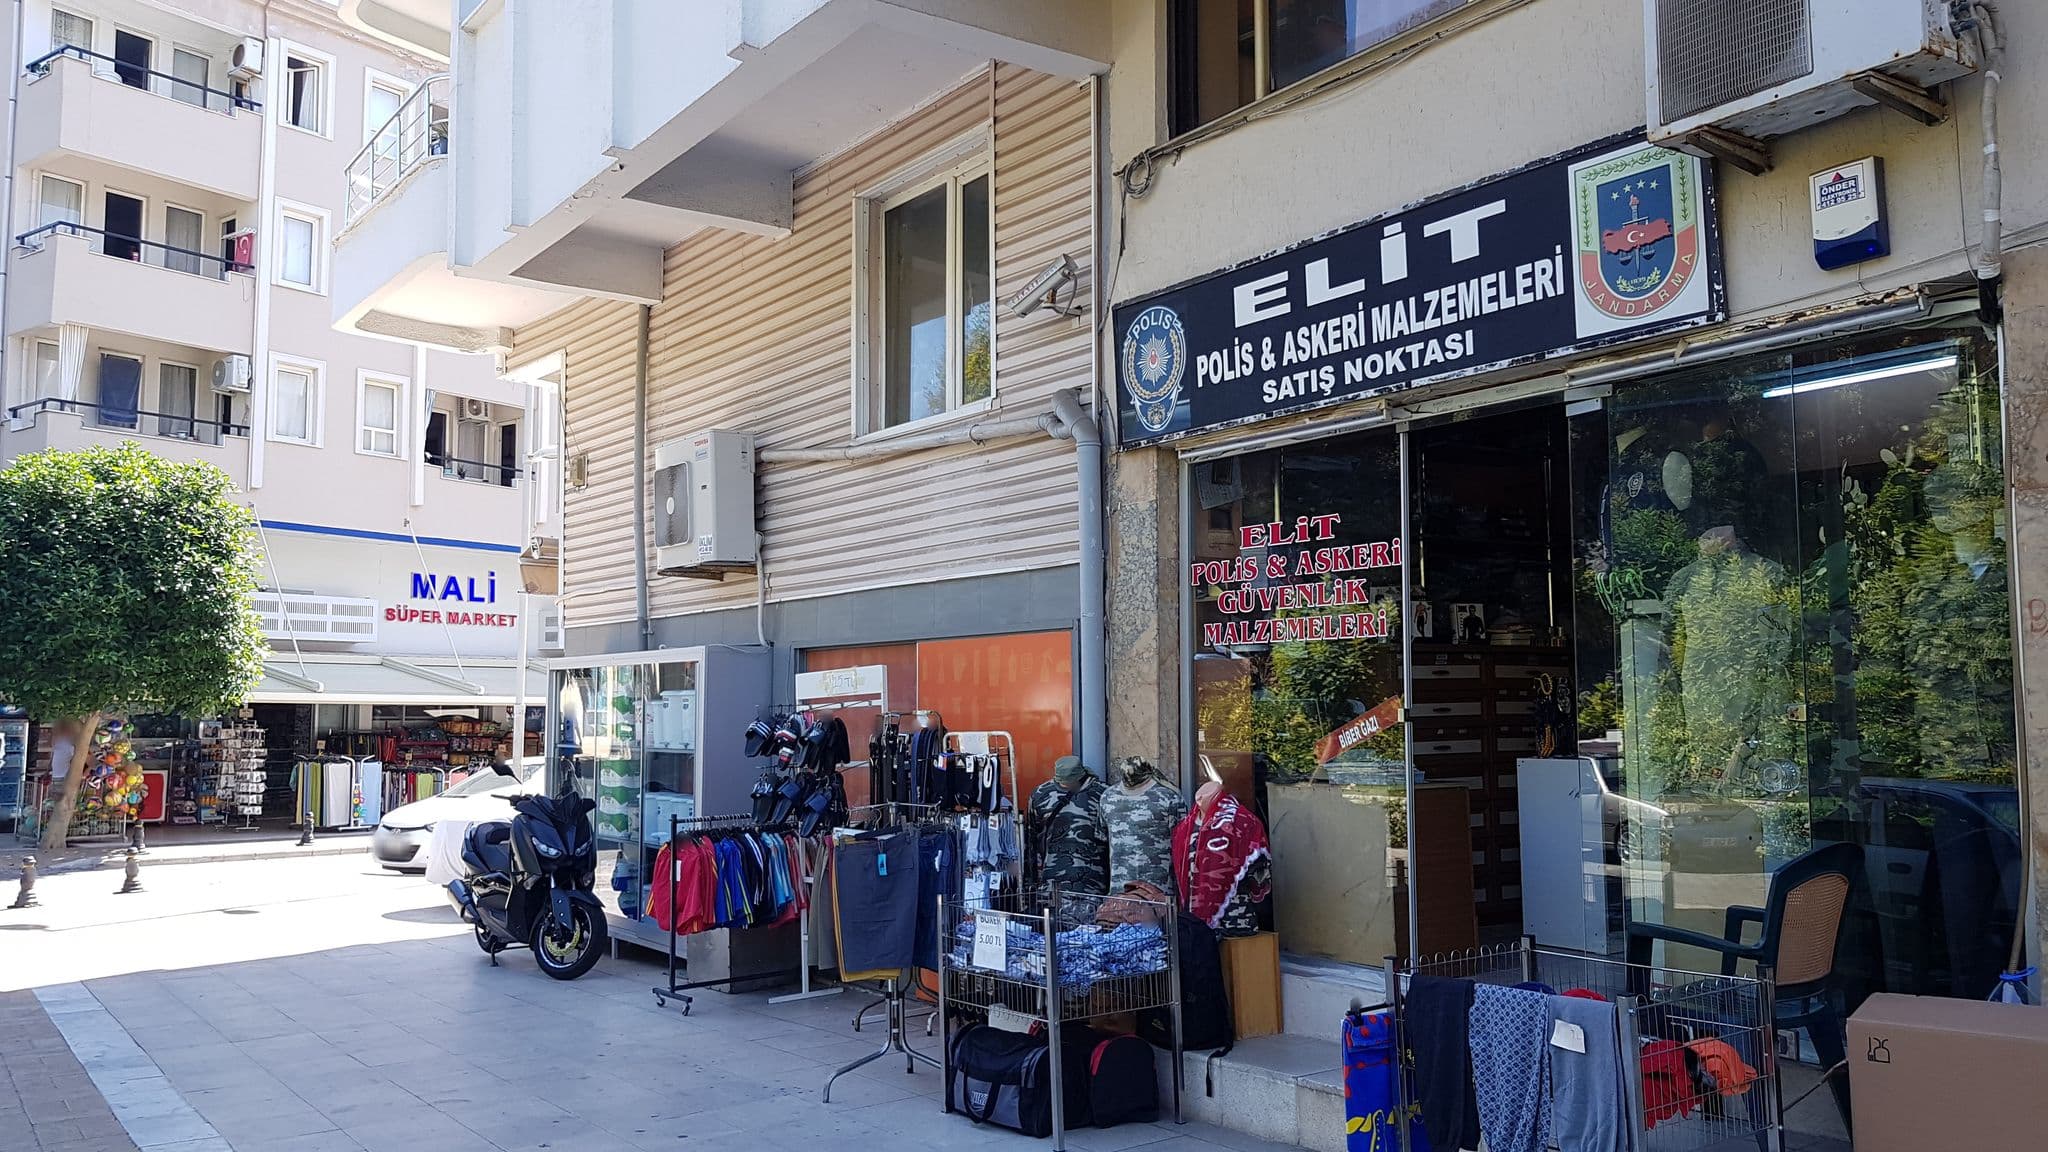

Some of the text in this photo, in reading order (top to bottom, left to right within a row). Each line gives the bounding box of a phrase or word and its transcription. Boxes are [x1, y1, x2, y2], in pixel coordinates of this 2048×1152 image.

[1821, 180, 1856, 196] ÖNDER
[1234, 200, 1506, 328] ELİT
[1584, 253, 1694, 315] JANDARMA
[1132, 309, 1173, 341] POLİS
[1197, 245, 1566, 388] POLİS & ASKERİ MALZEMELERİ
[1262, 330, 1475, 404] SATIŞ NOKTASI
[1266, 554, 1287, 579] &
[410, 571, 496, 603] MALİ
[384, 604, 518, 627] SÜPER MARKET
[1338, 715, 1380, 749] BİBER GAZI
[979, 934, 1002, 947] 5.00 TL
